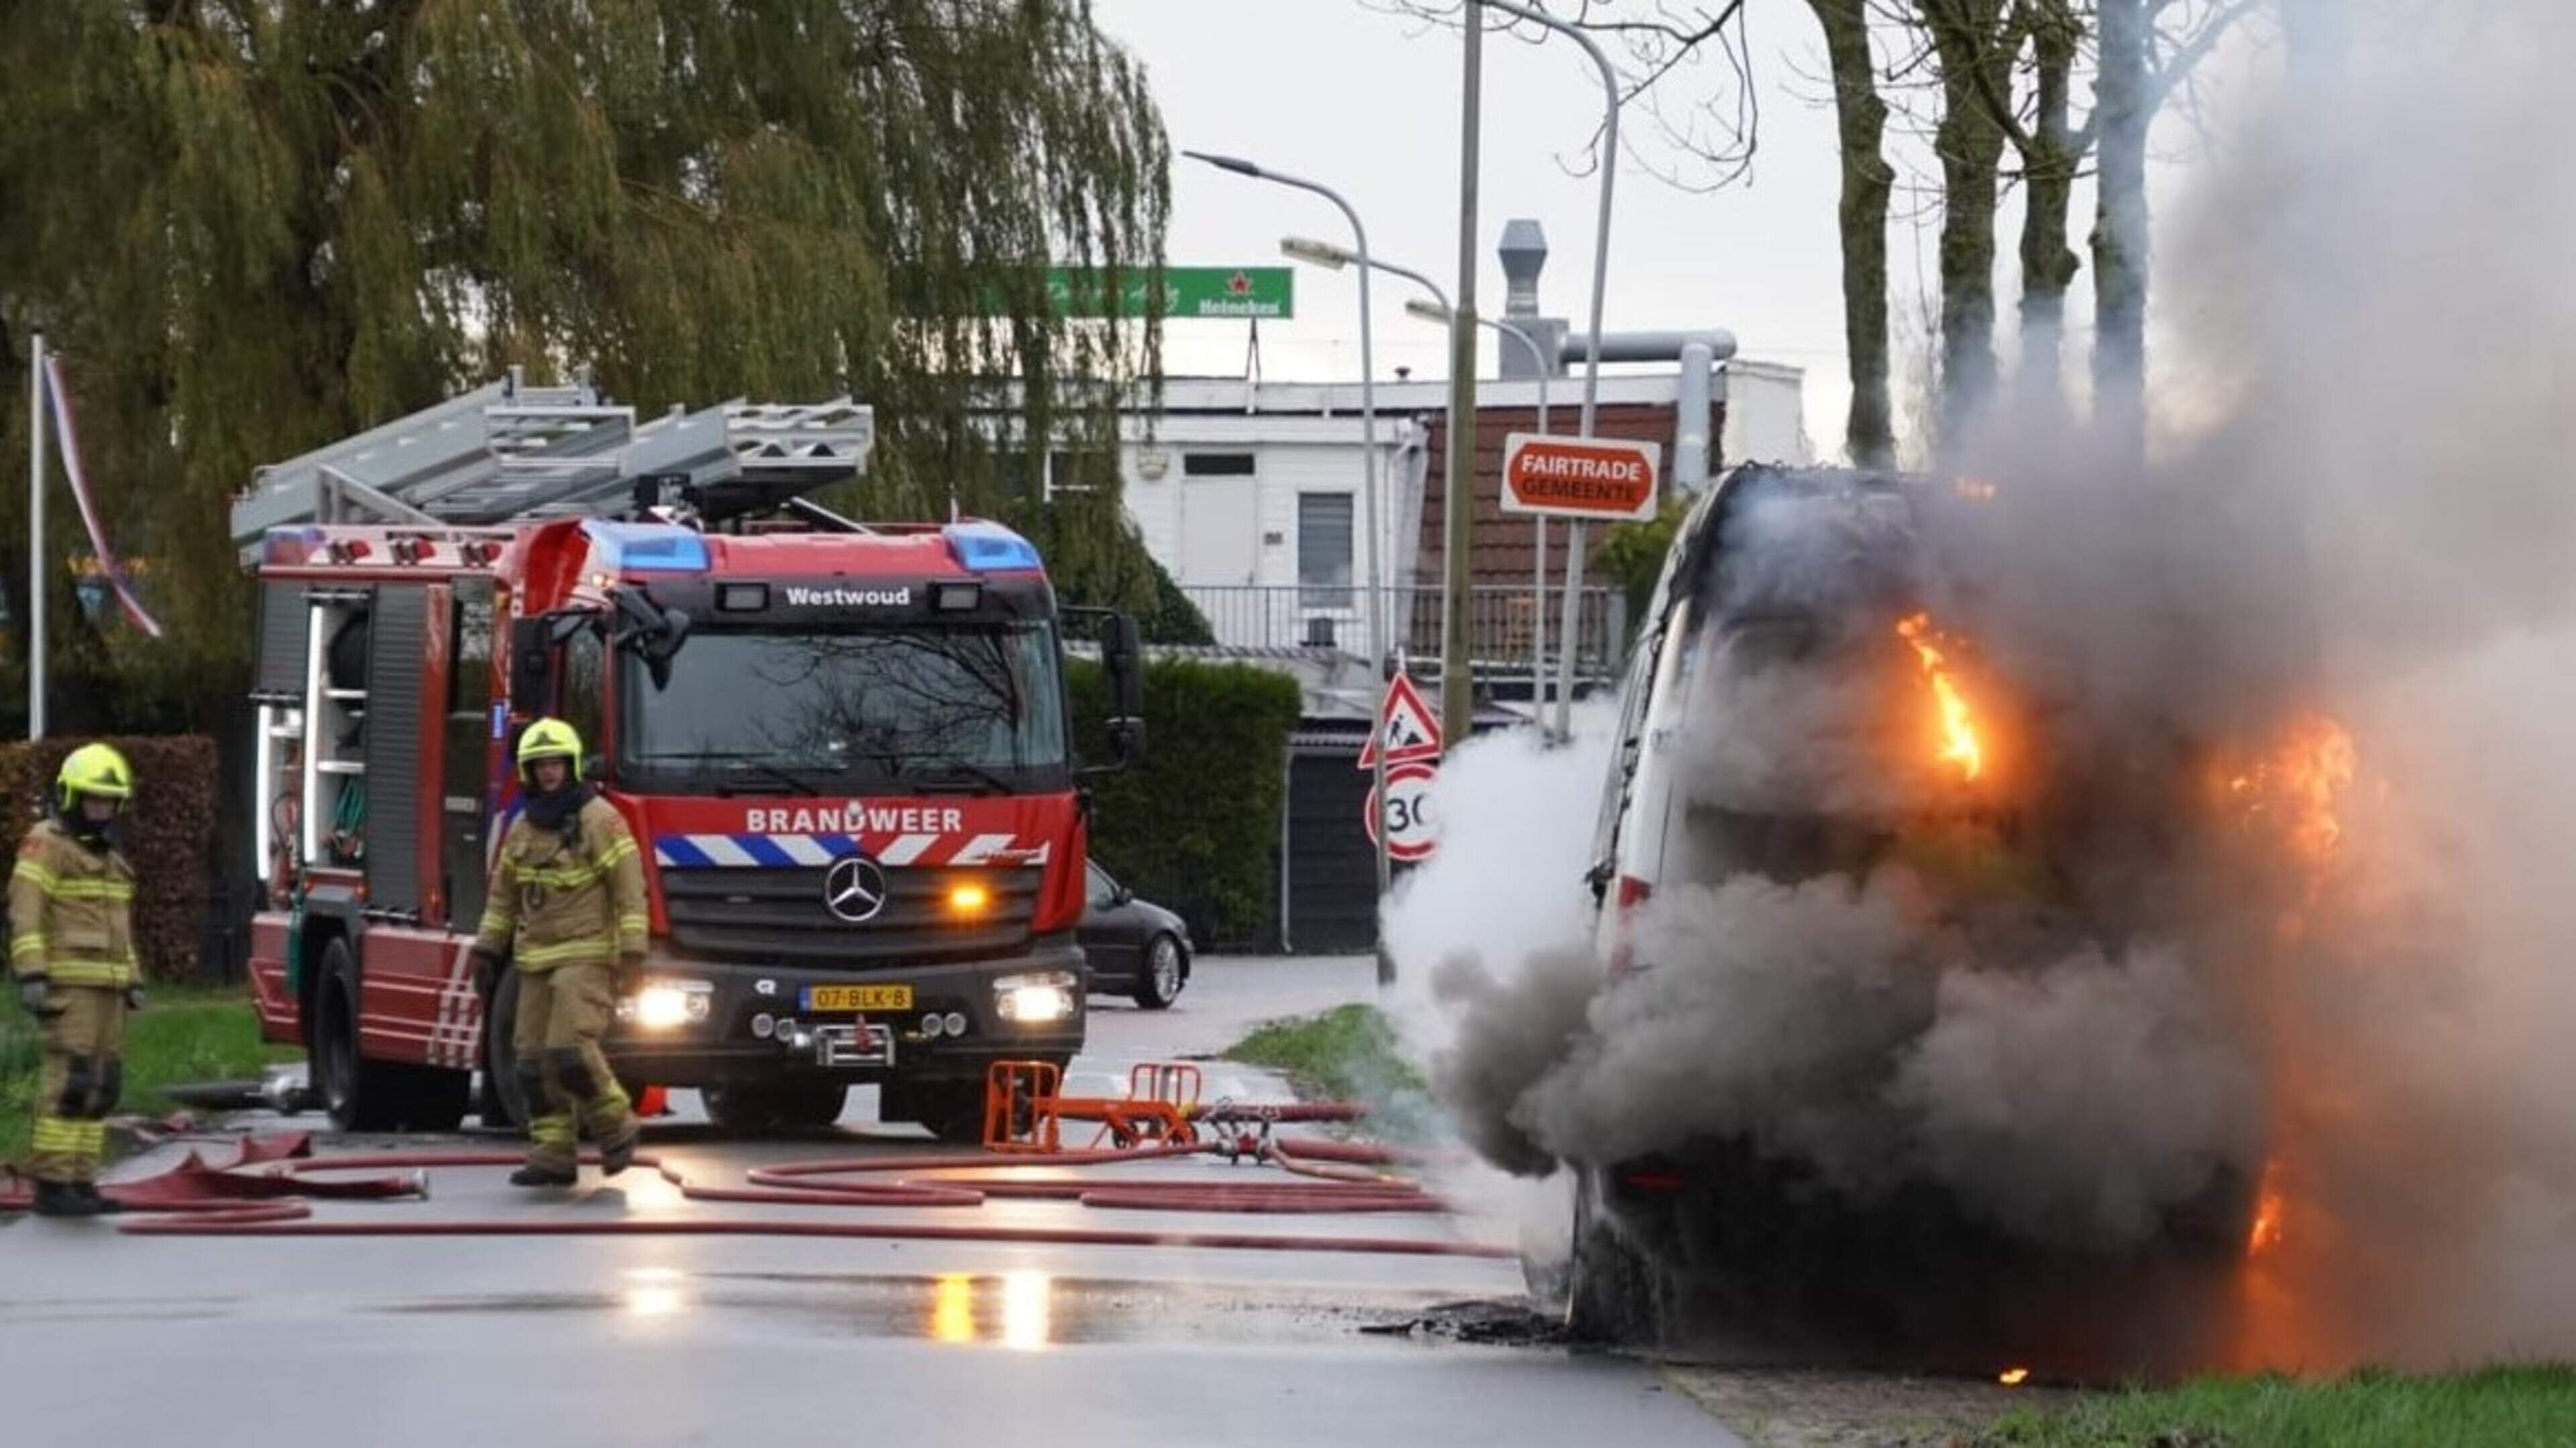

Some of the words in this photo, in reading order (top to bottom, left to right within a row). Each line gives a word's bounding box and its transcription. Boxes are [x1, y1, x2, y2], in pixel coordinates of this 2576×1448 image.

[1199, 299, 1279, 315] Heineken
[1521, 454, 1641, 481] FAIRTRADE
[1522, 477, 1635, 502] GEMEENTE
[786, 586, 910, 605] Westwoud
[747, 808, 961, 832] BRANDWEER
